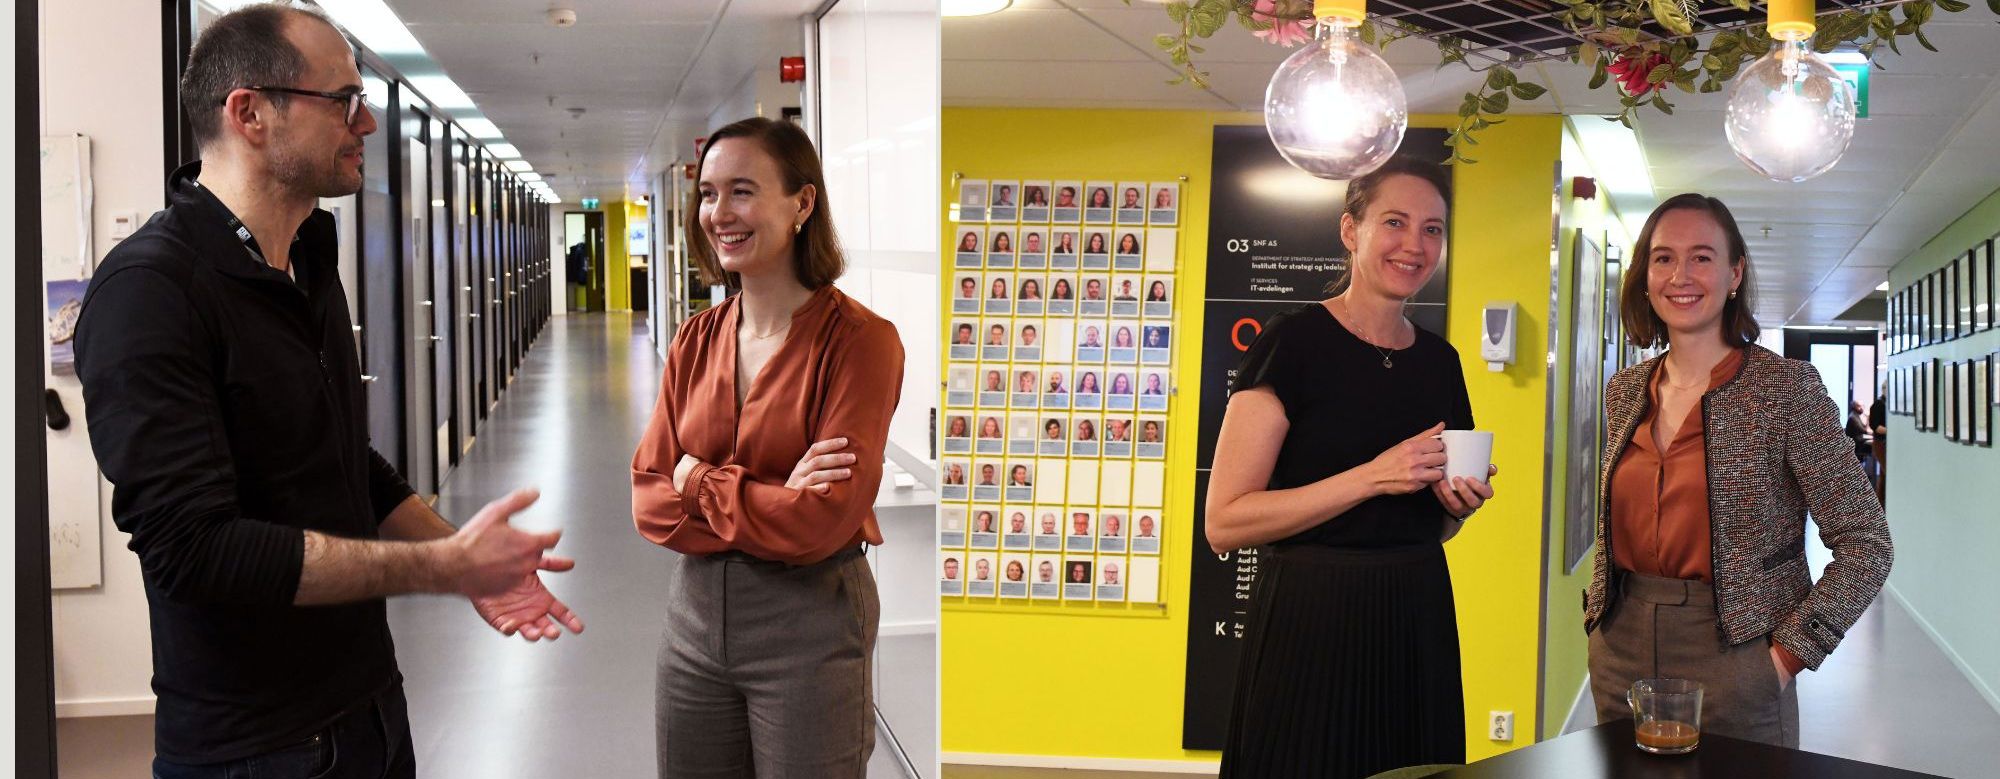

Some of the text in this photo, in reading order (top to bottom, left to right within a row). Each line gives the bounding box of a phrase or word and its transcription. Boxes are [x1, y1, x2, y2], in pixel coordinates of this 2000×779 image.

[1289, 263, 1314, 272] strategi
[1250, 284, 1294, 294] IT-avdelingen
[1216, 622, 1226, 636] K
